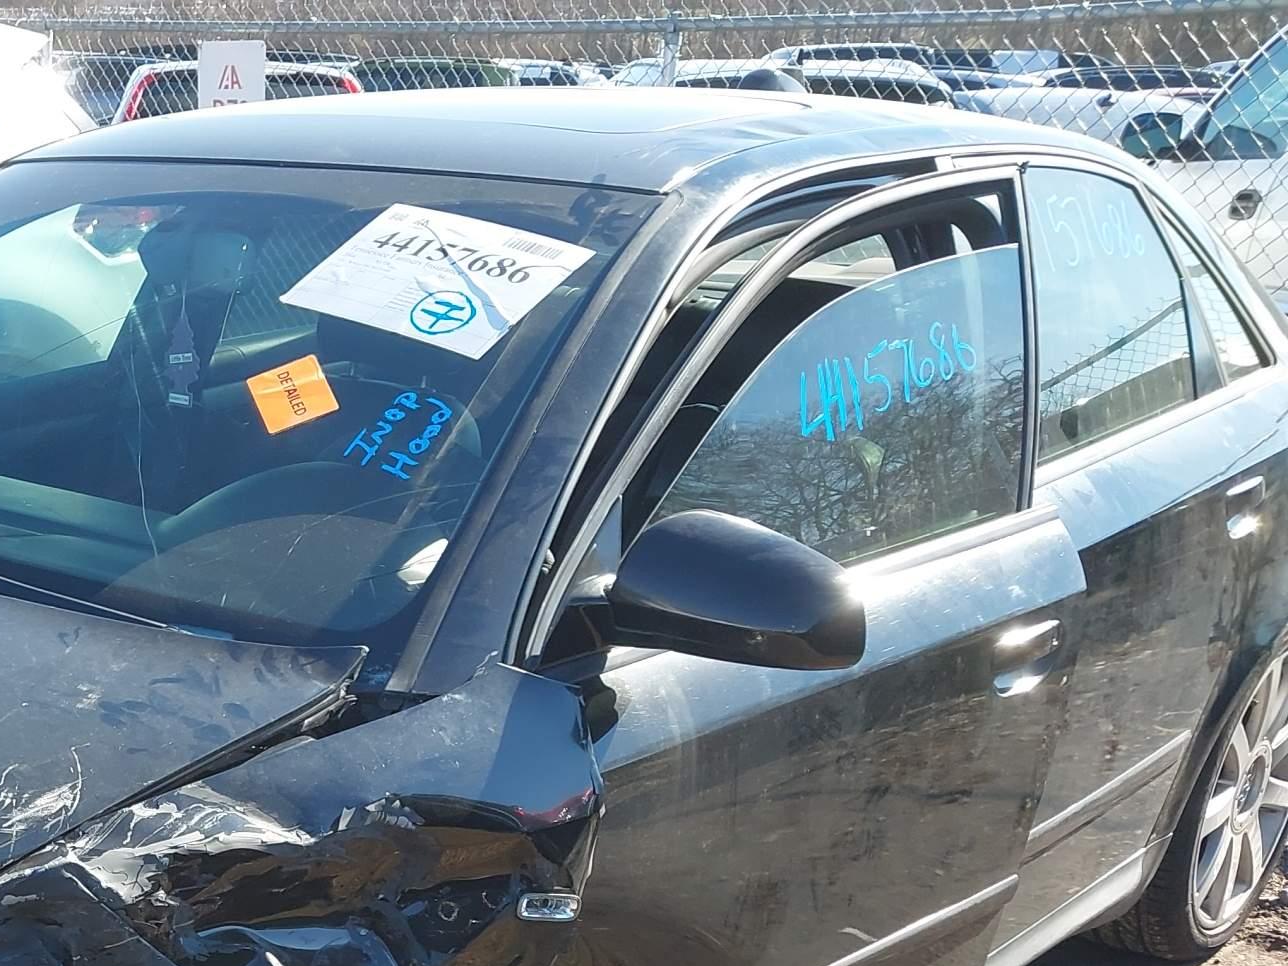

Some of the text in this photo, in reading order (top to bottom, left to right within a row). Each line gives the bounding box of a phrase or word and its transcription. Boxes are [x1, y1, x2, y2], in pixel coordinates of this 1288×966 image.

[372, 231, 531, 284] 44157686
[276, 371, 308, 417] DETAILED
[800, 320, 978, 442] 44157686
